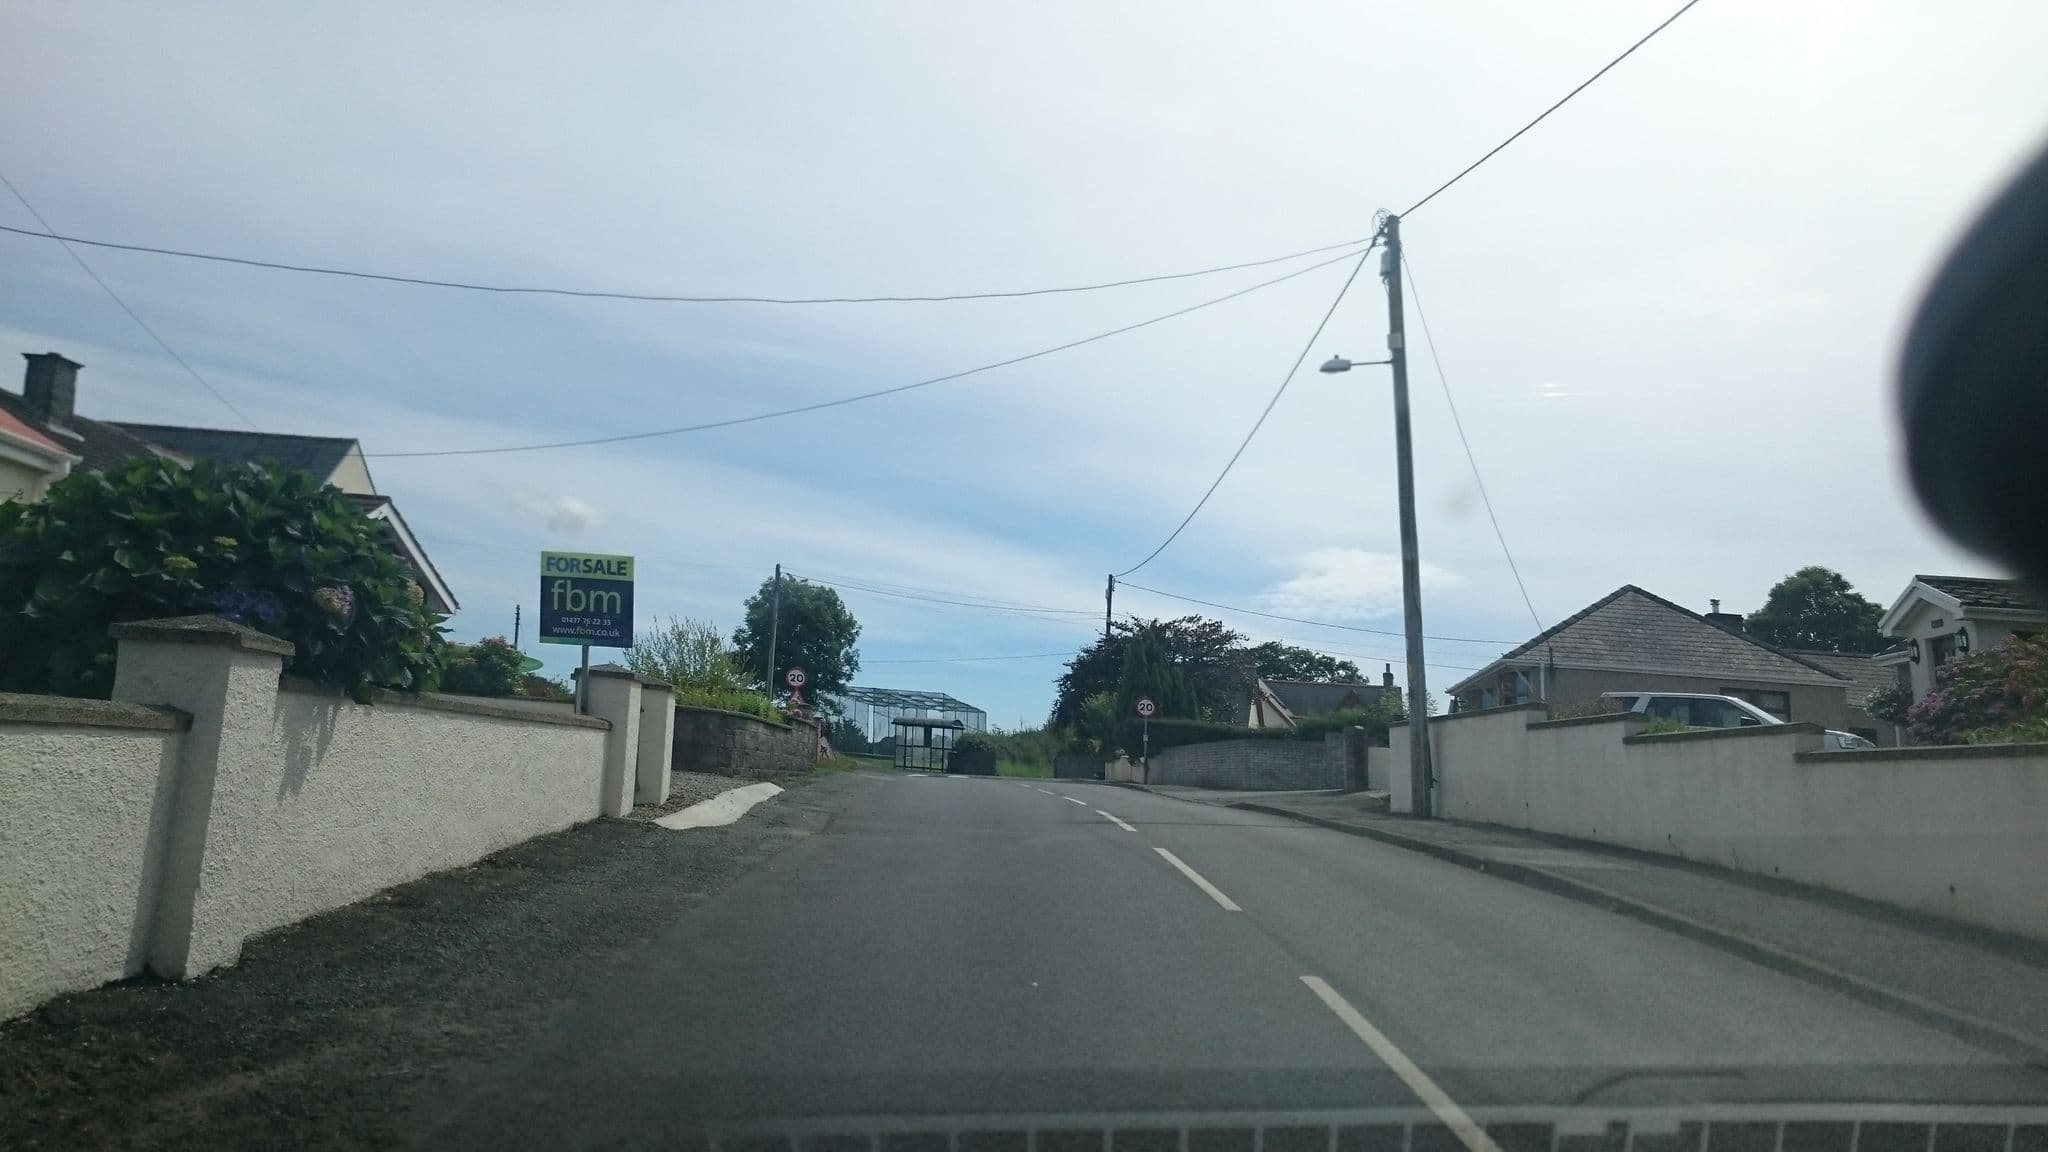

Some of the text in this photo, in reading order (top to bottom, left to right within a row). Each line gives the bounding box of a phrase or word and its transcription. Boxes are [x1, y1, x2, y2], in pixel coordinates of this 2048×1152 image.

[551, 580, 621, 614] fbm
[553, 626, 620, 637] www.fbm.co.uk
[789, 673, 804, 682] 20
[1139, 703, 1153, 711] 20
